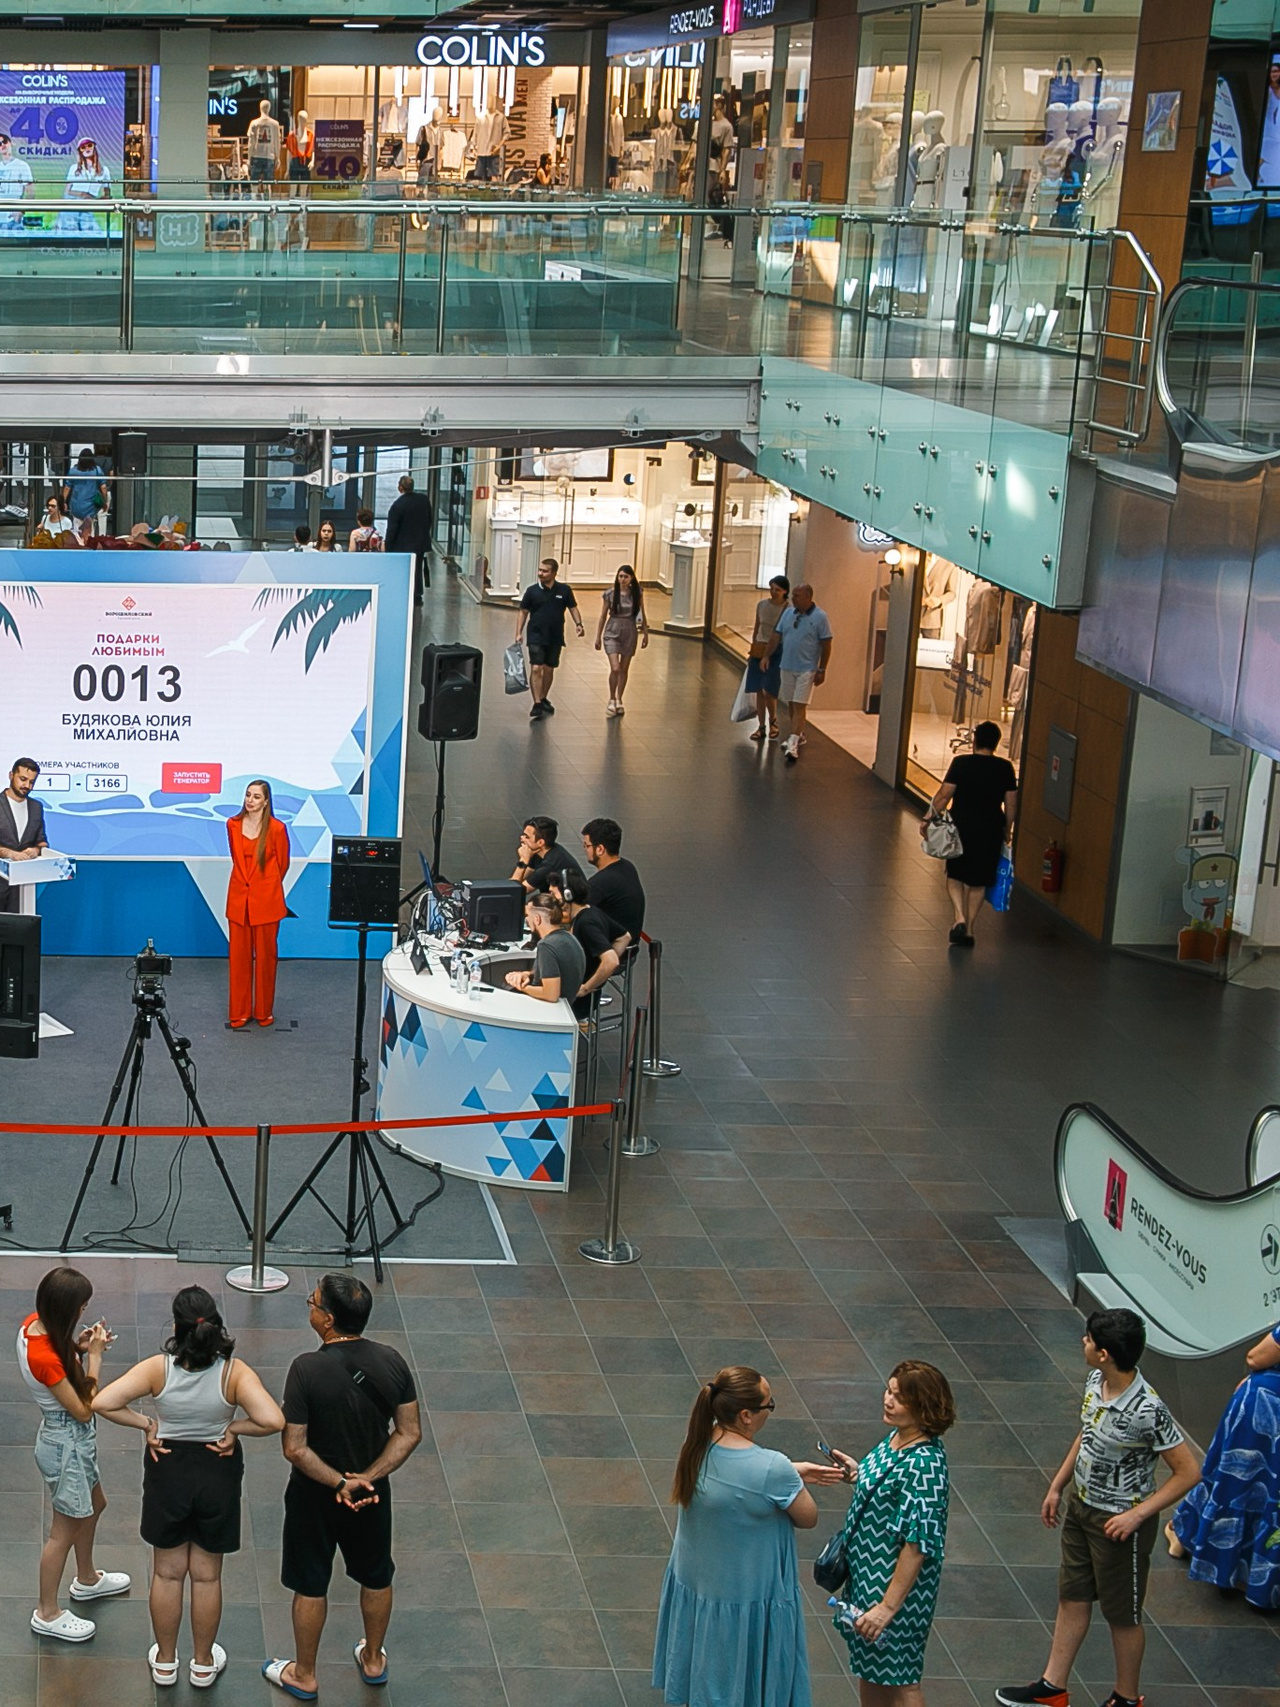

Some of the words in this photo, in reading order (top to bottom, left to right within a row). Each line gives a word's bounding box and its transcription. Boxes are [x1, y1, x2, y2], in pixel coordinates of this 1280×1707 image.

[670, 6, 714, 33] RENDEZ-VOUS
[417, 31, 545, 66] COLIN'S
[22, 74, 68, 87] COLIN'S
[48, 96, 106, 105] РАСПРОДАЖА
[10, 107, 79, 145] 40
[97, 634, 160, 644] ПОДАРКИ
[91, 646, 165, 656] ЛЮБИМЫМ
[73, 664, 182, 702] 0013
[62, 713, 140, 727] БУДЯКОВА
[146, 714, 192, 727] ЮЛИЯ
[65, 761, 120, 769] УЧАСТНИКОВ
[93, 778, 120, 788] 3166
[1130, 1197, 1207, 1284] RENDEZ-VOUS
[1263, 1292, 1270, 1307] 2
